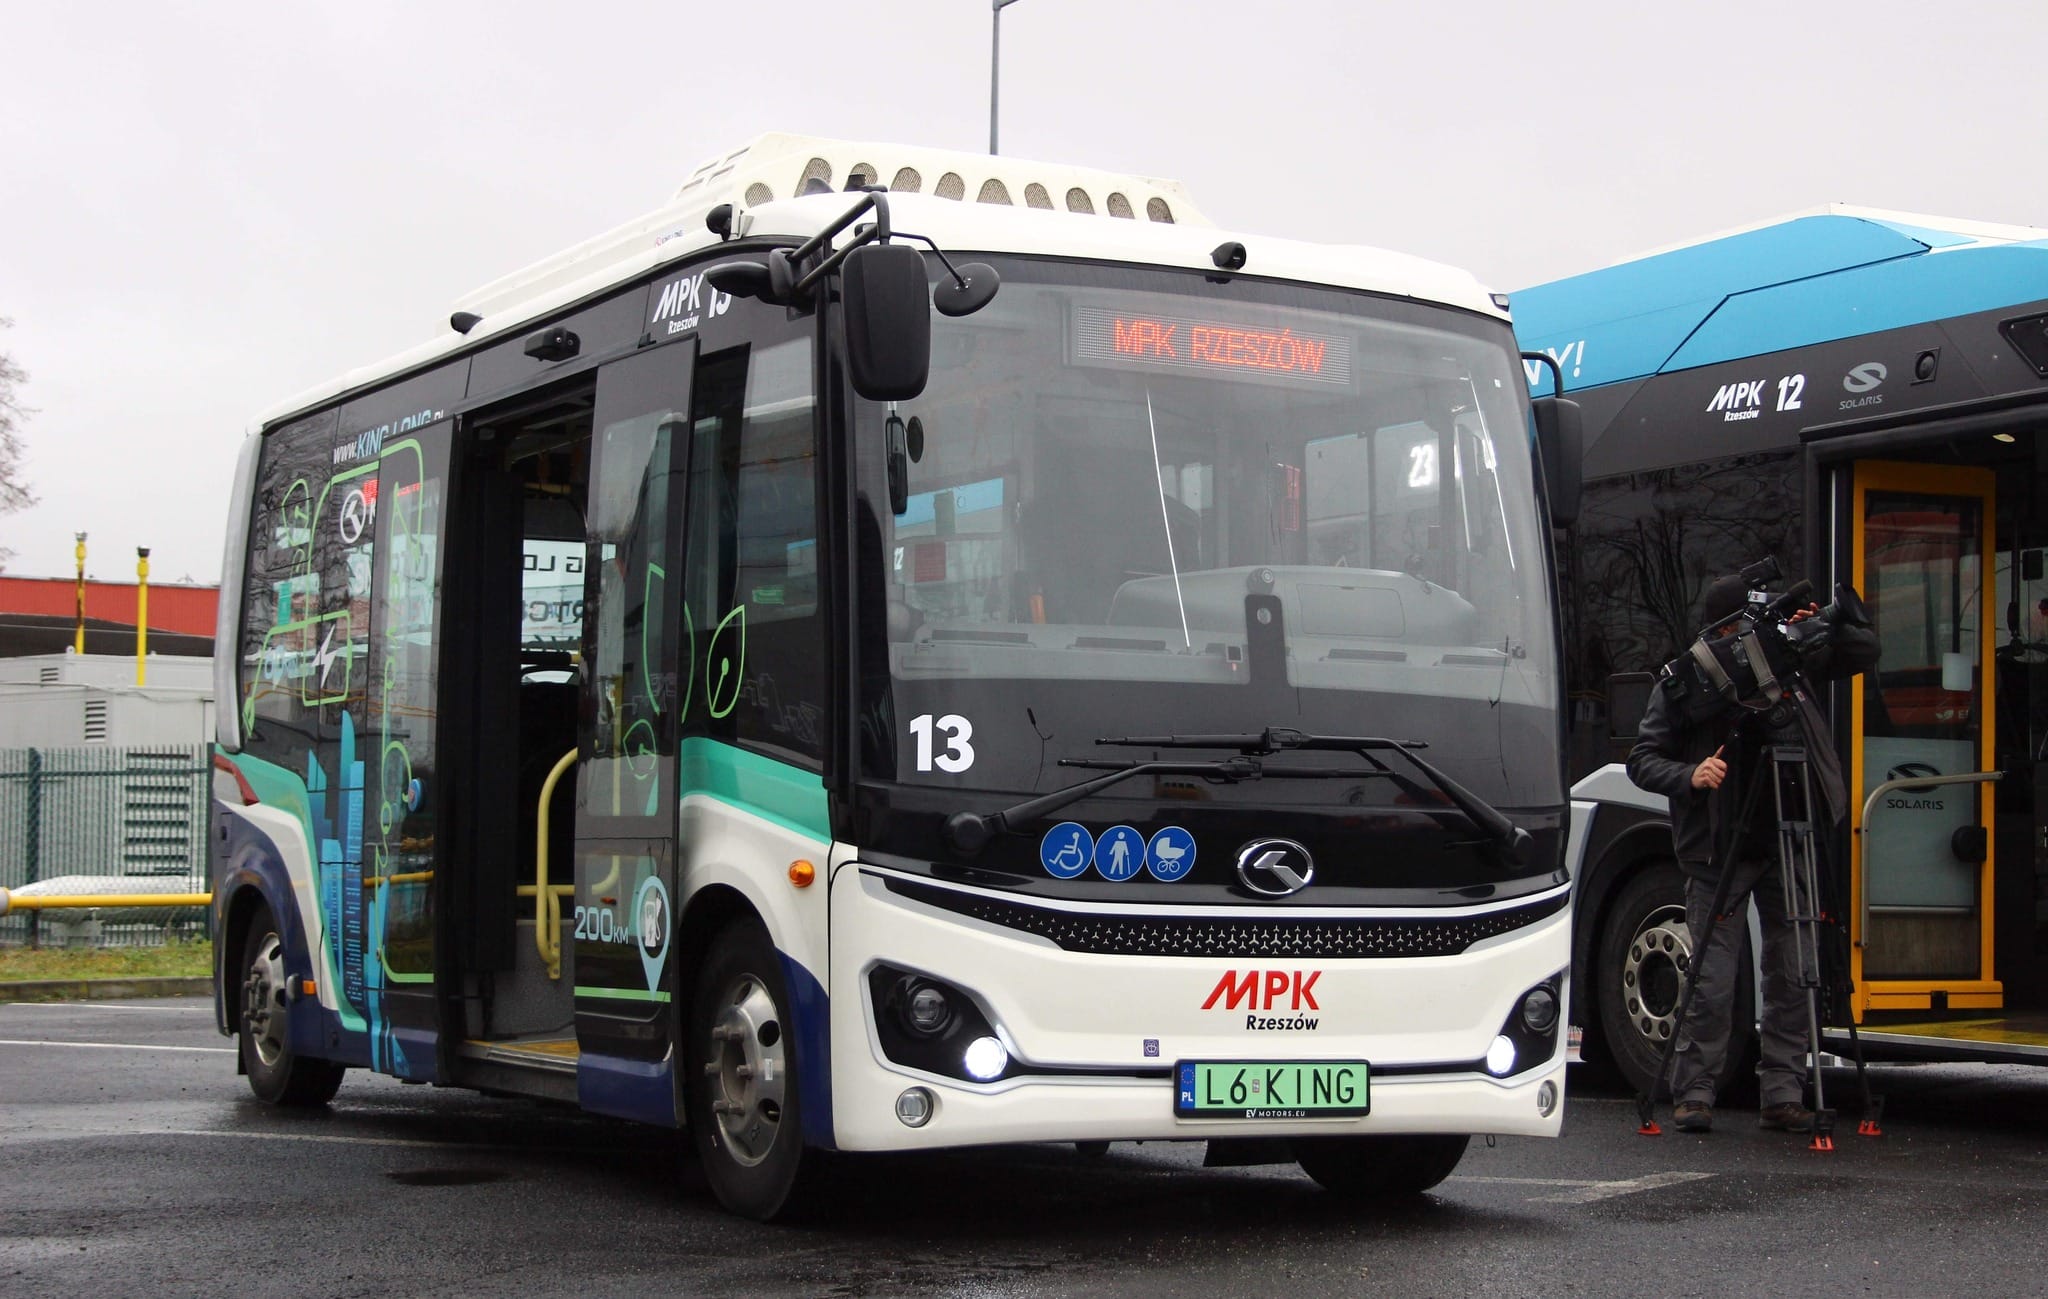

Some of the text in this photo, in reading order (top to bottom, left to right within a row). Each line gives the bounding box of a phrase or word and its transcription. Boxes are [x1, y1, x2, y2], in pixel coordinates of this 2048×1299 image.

[652, 273, 704, 323] MPK
[668, 311, 700, 335] Rzeszów
[1115, 318, 1325, 373] MPK RZESZÓW
[1706, 373, 1806, 412] MPK 12
[1839, 394, 1883, 410] SOLARIS
[1724, 406, 1760, 422] Rzeszów
[909, 714, 975, 773] 13
[1887, 799, 1944, 810] SOLARIS
[1200, 970, 1322, 1010] MPK
[1246, 1012, 1319, 1030] Rzeszów
[1181, 1092, 1194, 1102] PL
[1206, 1068, 1354, 1105] L6 KING
[1246, 1108, 1306, 1118] EV MOTORS.EU
